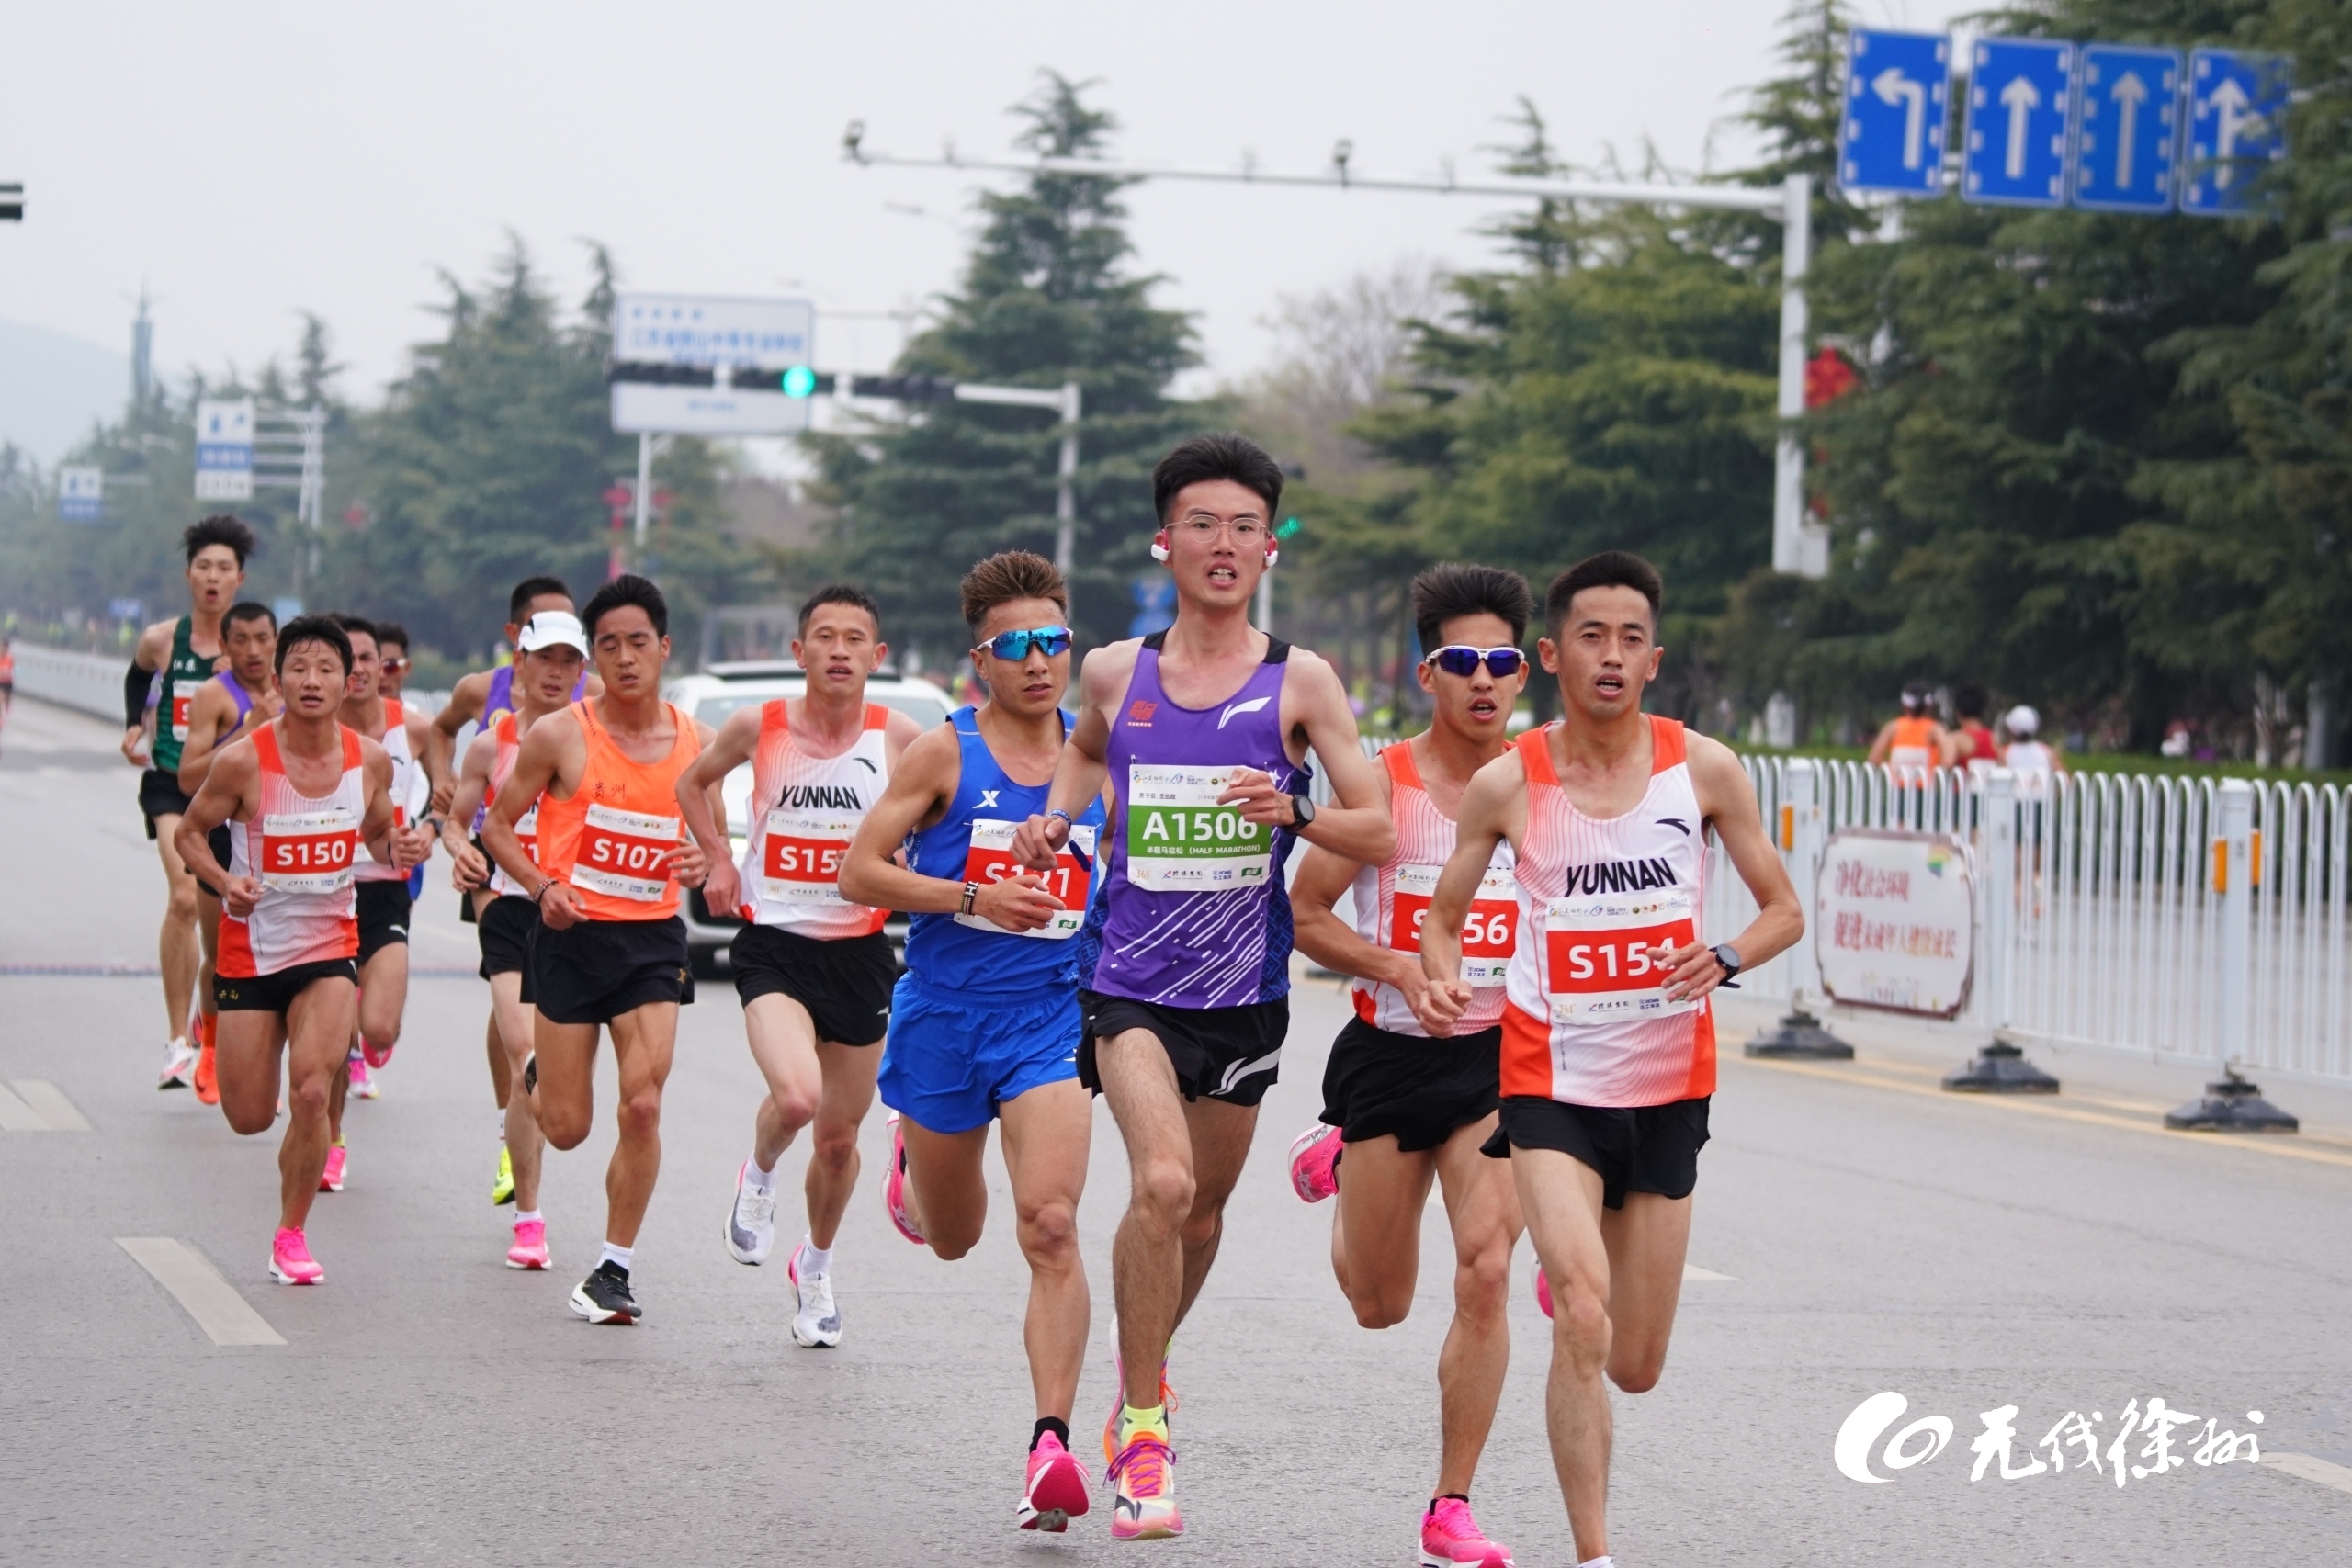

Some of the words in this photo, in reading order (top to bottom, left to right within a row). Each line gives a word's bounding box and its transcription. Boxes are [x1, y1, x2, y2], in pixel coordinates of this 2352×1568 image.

[777, 784, 862, 810] YUNNAN
[1142, 811, 1258, 841] A1506
[277, 840, 346, 866] S150
[592, 838, 665, 872] S107
[779, 845, 838, 874] S15
[1563, 856, 1678, 898] YUNNAN
[1410, 908, 1509, 945] S56
